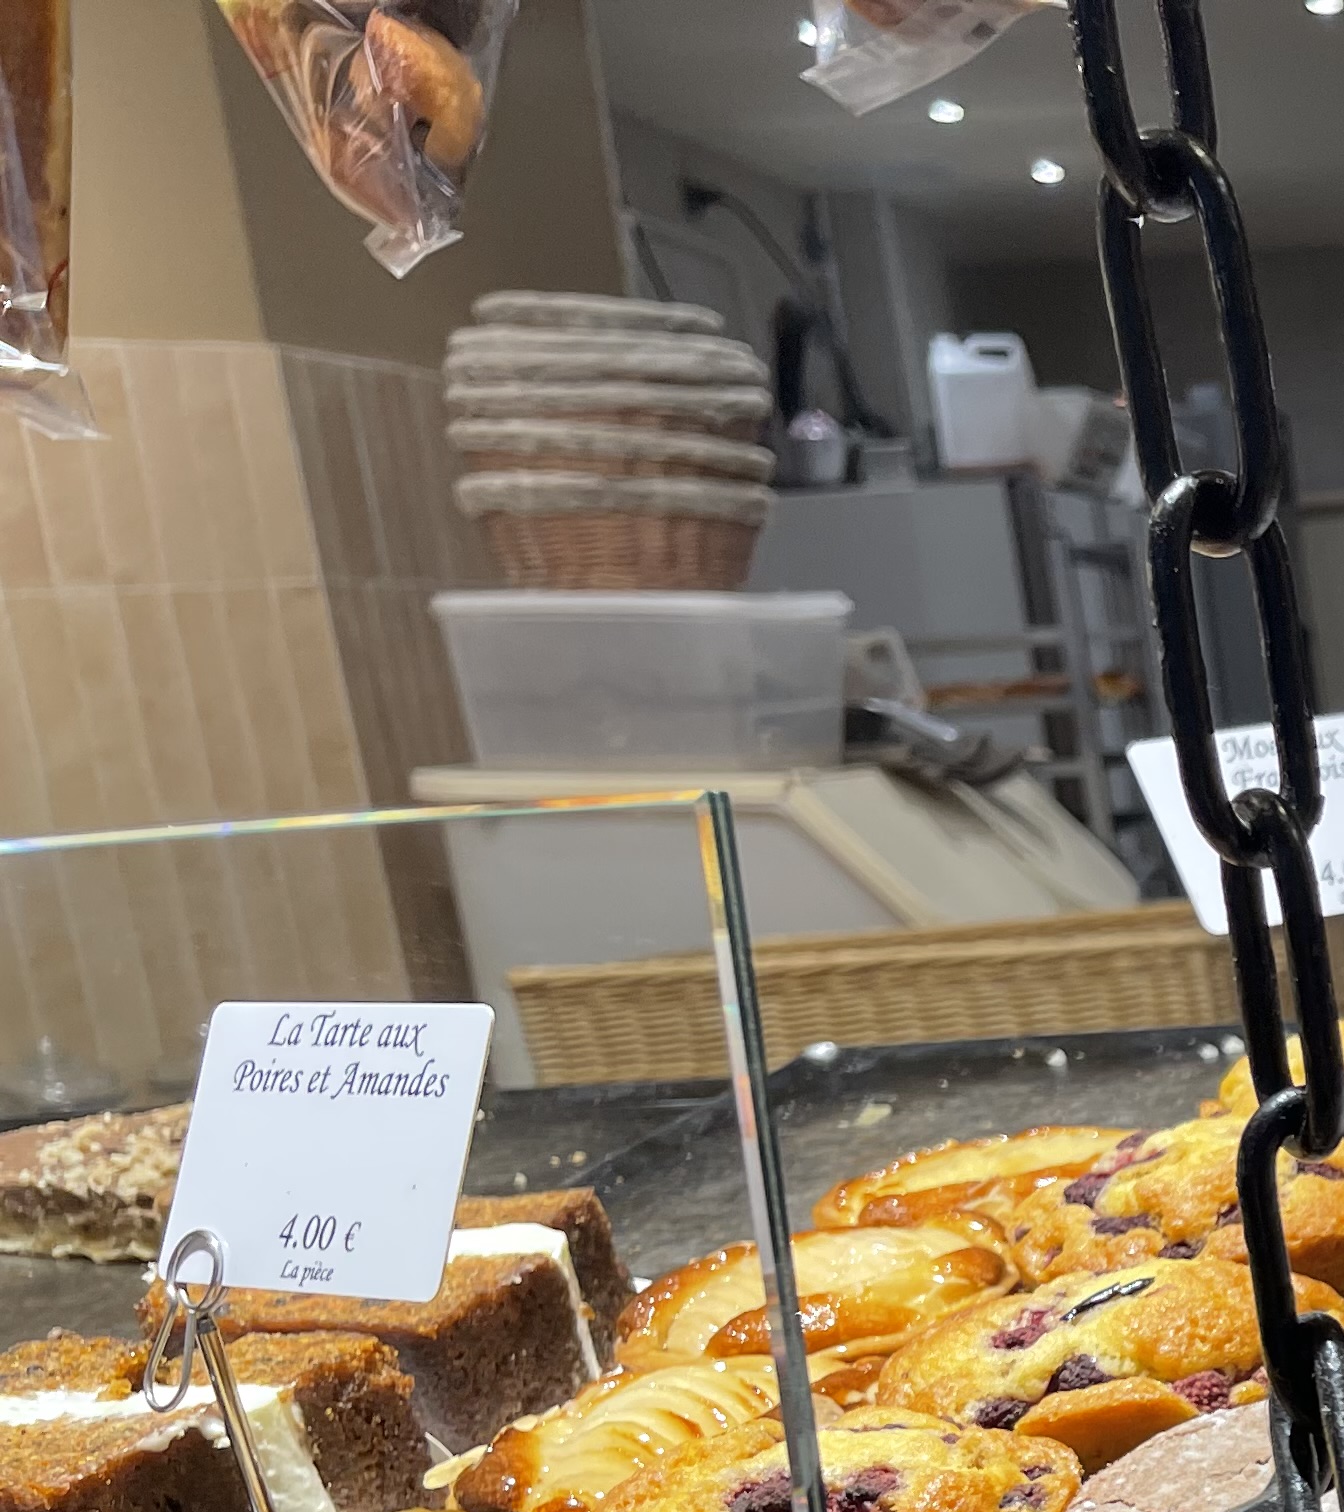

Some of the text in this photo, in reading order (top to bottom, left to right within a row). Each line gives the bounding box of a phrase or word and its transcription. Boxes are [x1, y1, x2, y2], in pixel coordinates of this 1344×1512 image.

[268, 1010, 427, 1057] La Tarte aux
[233, 1058, 450, 1100] Poires et Amandes
[279, 1213, 362, 1252] 4.00 €
[280, 1260, 334, 1287] La pièce
